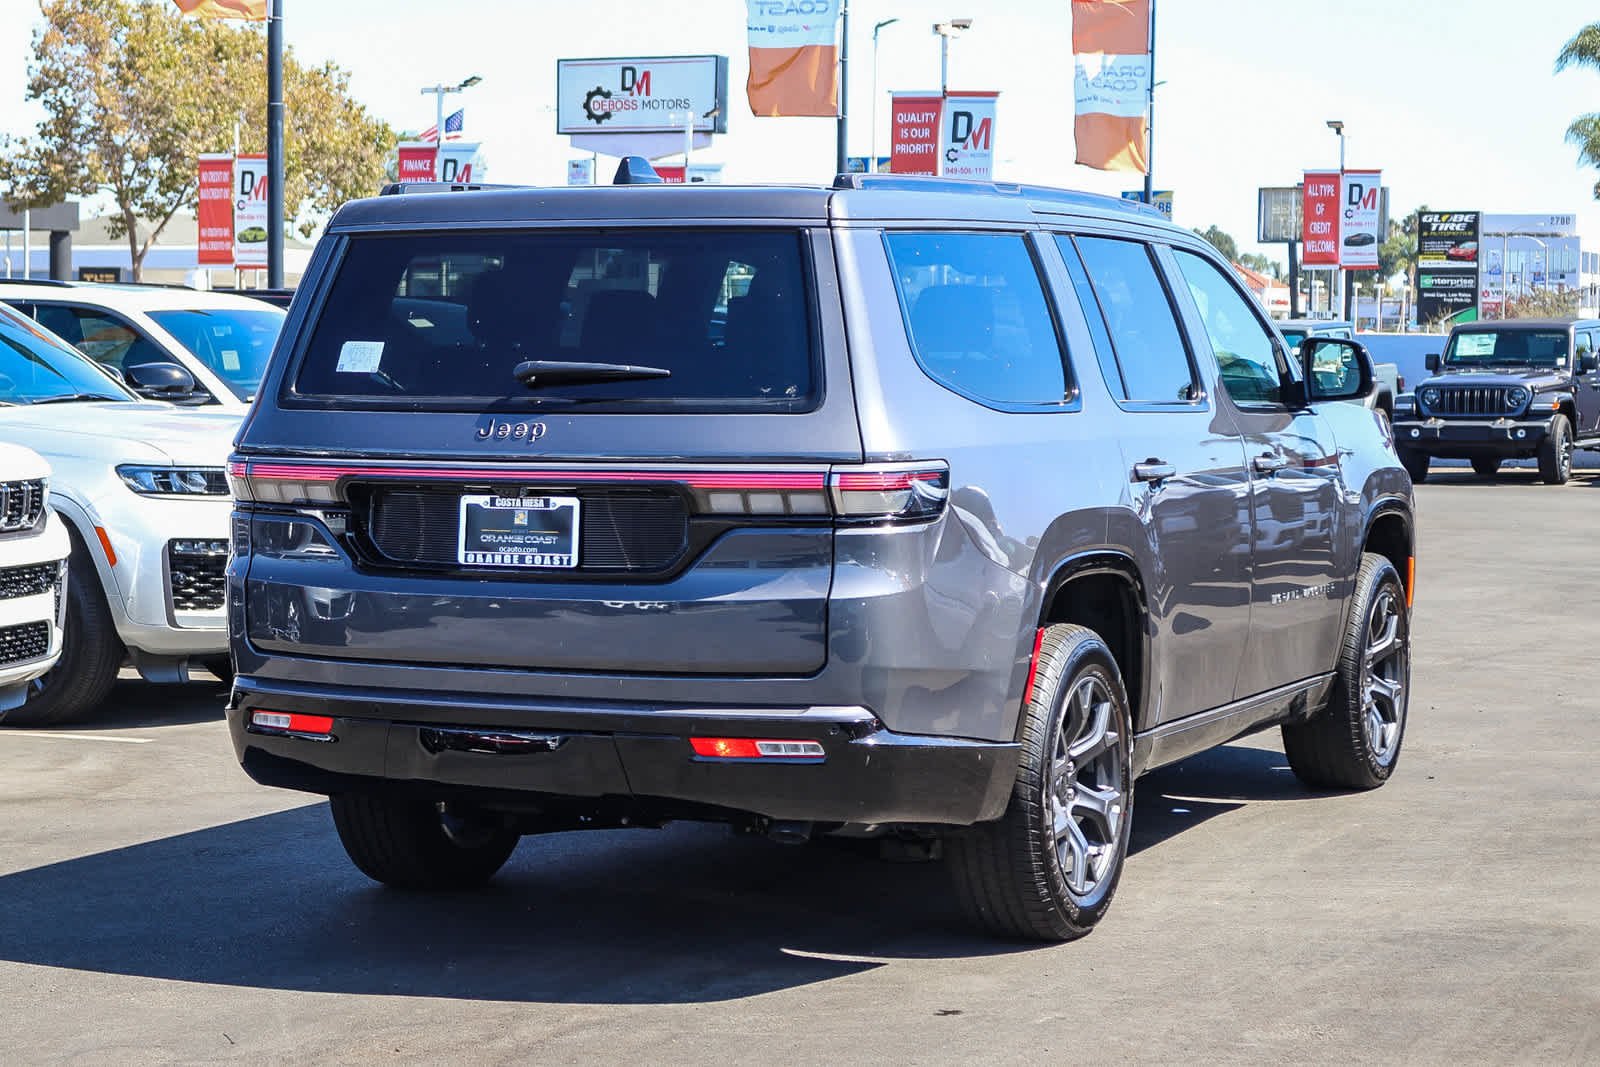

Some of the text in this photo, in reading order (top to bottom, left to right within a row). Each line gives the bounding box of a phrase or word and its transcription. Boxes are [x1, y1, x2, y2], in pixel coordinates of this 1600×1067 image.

[621, 66, 651, 97] DM
[592, 99, 690, 111] DEBOSS MOTORS
[897, 112, 936, 123] QUALITY
[900, 127, 930, 138] IS OUR
[952, 111, 992, 150] DM
[895, 143, 935, 154] PRIORITY
[403, 159, 431, 170] FINANCE
[443, 158, 472, 183] DM
[241, 170, 268, 201] DM
[1308, 183, 1335, 197] ALL TYPE
[1349, 183, 1377, 210] DM
[1316, 203, 1325, 216] OF
[1310, 221, 1331, 235] CREDIT
[1431, 223, 1467, 231] TIRE
[1306, 240, 1335, 253] WELCOME
[1424, 278, 1474, 286] enterprise
[477, 418, 547, 442] Jeep
[495, 498, 544, 508] COSTA MESA
[480, 534, 559, 544] ORANGE COAST
[498, 545, 538, 553] ocauto.com
[466, 554, 569, 566] ORANGE COAST
